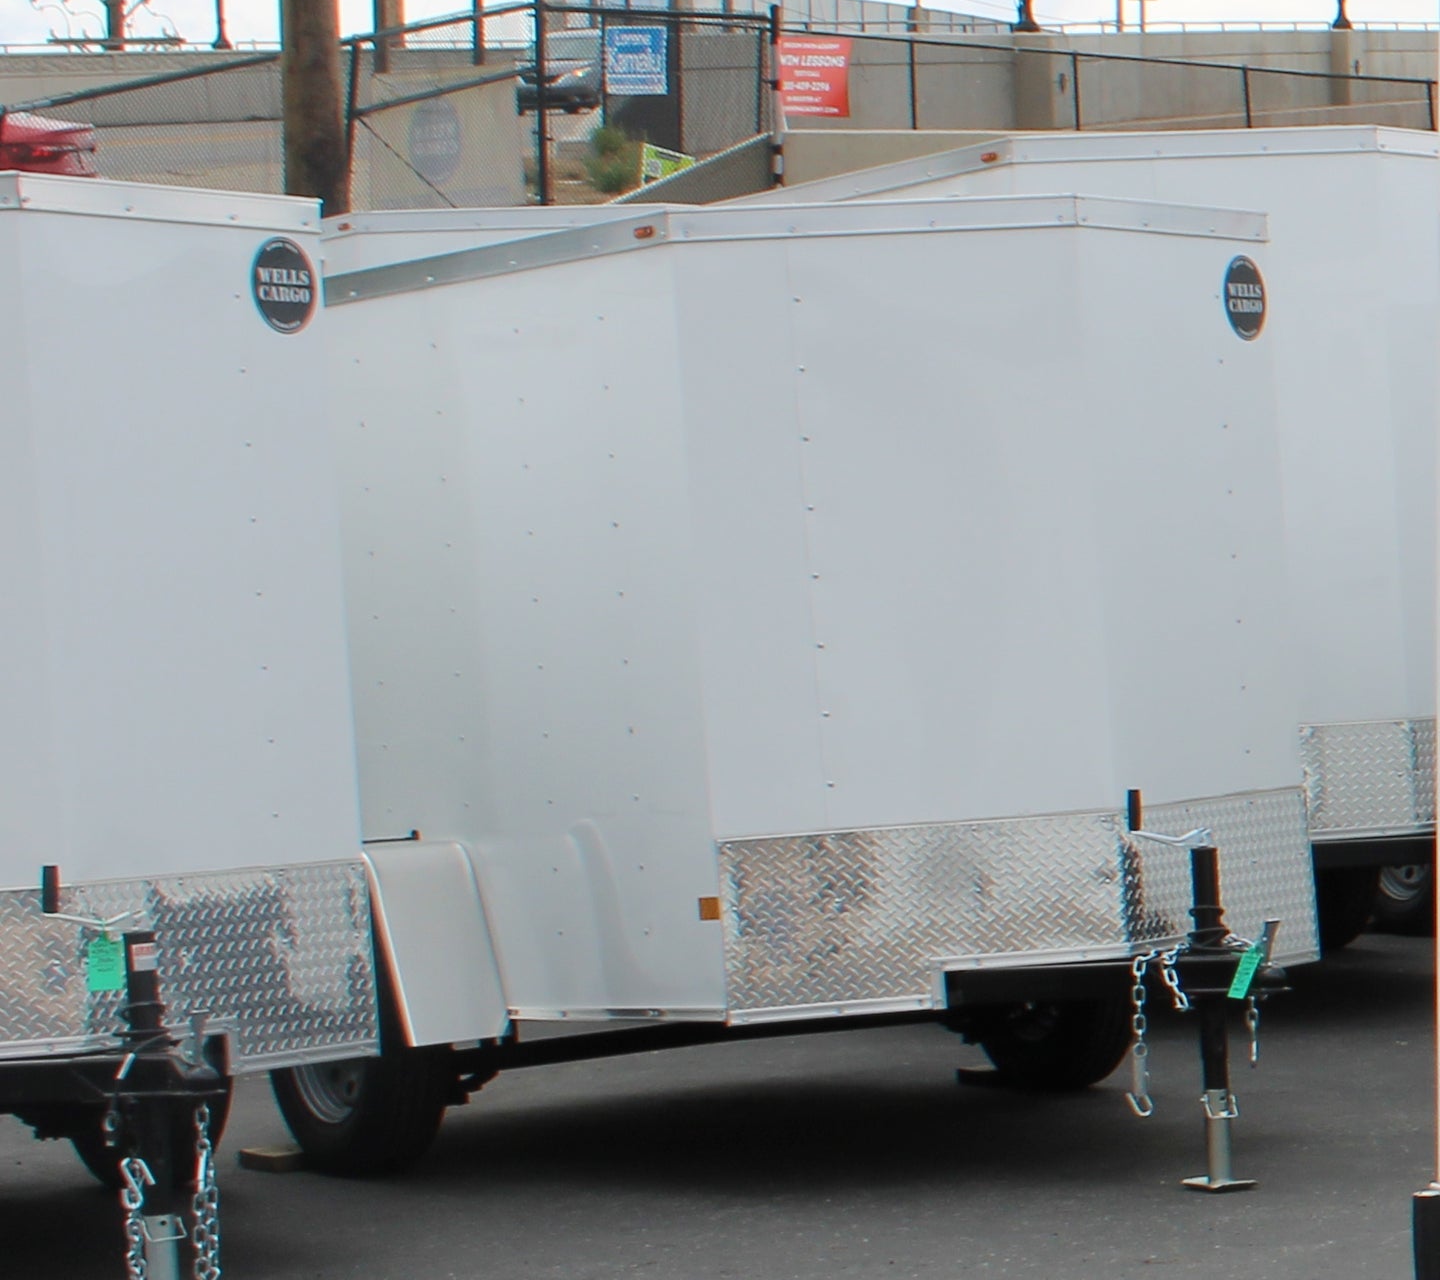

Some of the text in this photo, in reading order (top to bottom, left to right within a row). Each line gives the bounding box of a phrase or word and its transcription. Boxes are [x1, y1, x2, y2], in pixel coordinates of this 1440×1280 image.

[801, 54, 845, 68] LESSONS
[257, 267, 311, 286] WELLS
[258, 286, 311, 304] CARGO
[1228, 283, 1262, 298] WELLS
